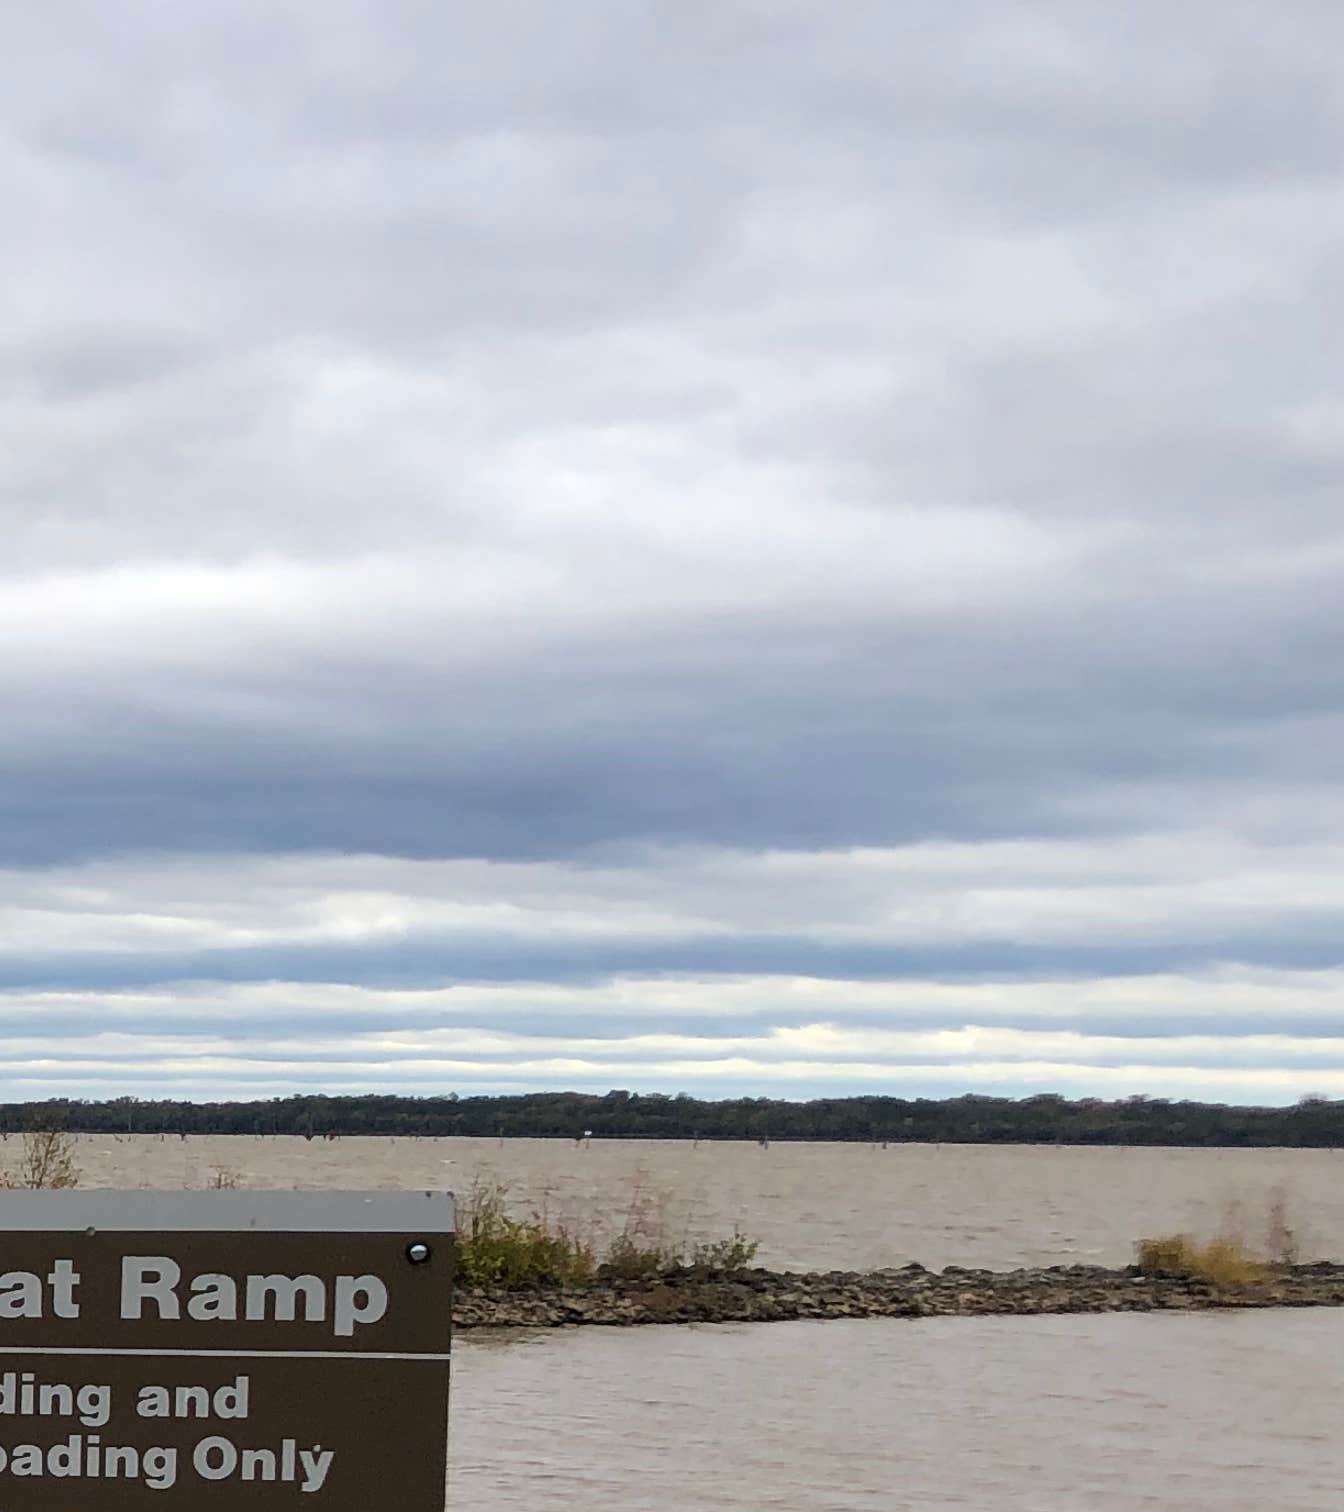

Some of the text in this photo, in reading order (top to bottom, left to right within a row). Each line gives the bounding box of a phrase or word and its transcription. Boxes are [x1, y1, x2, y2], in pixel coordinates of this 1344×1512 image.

[119, 1255, 389, 1337] Ramp
[136, 1376, 250, 1419] and
[192, 1436, 335, 1493] Only
